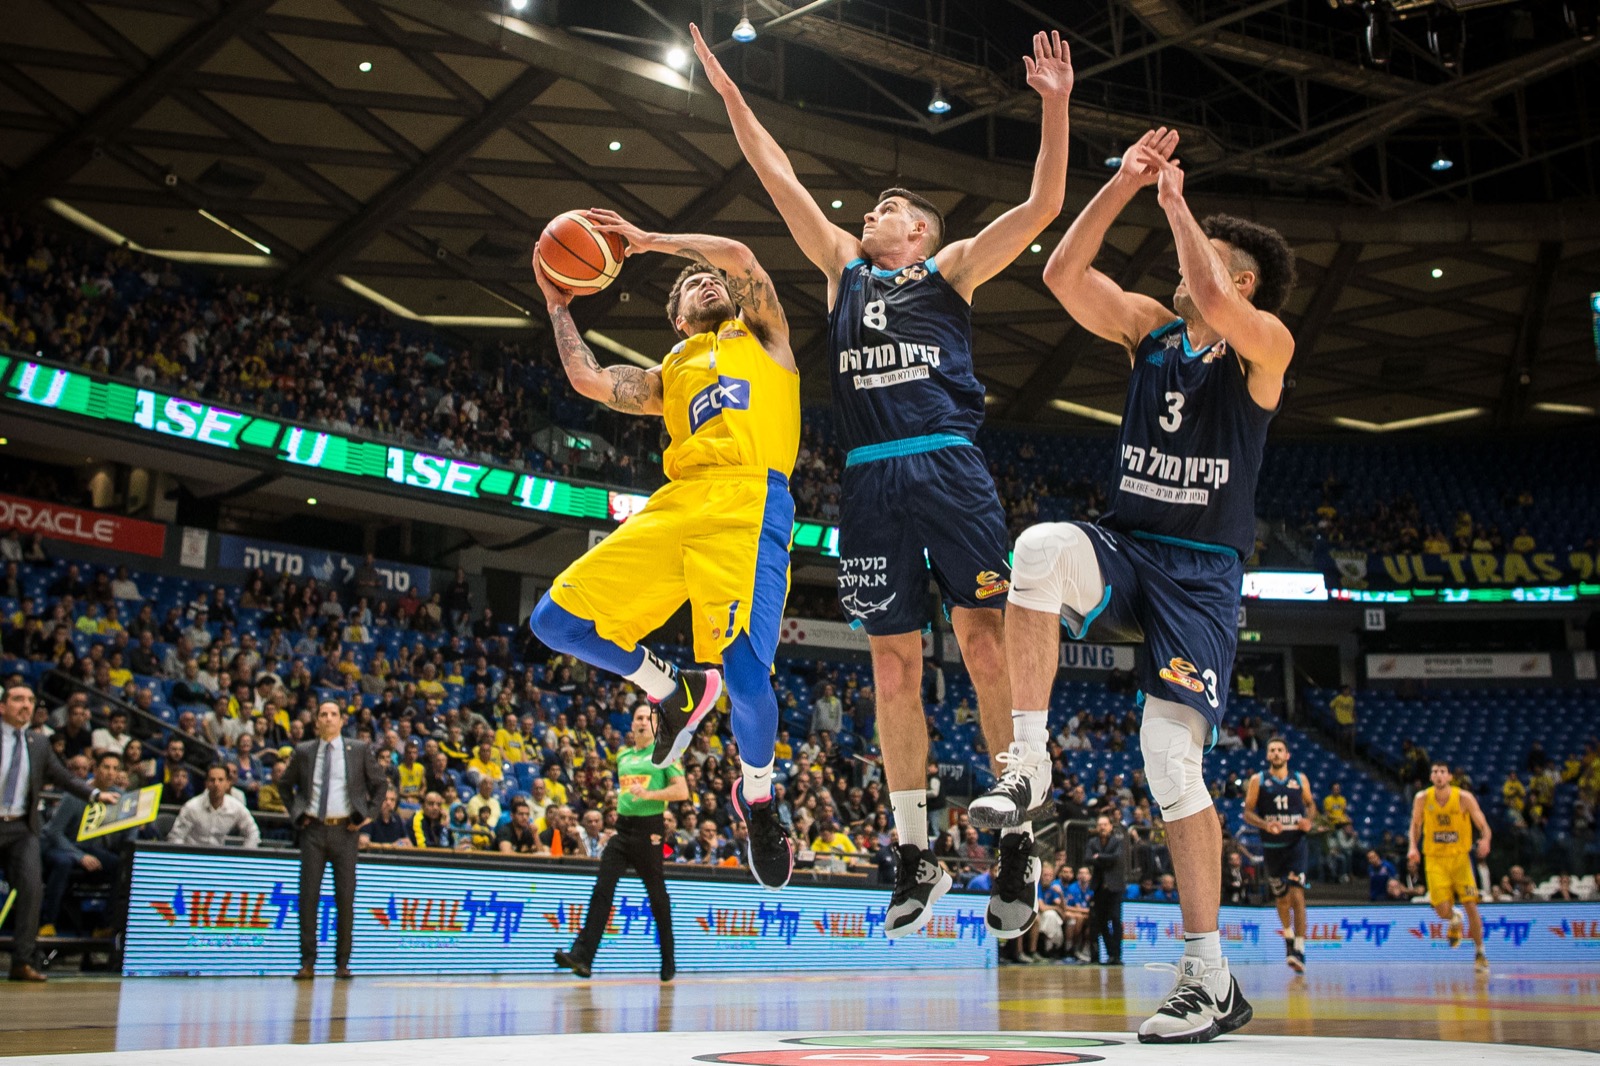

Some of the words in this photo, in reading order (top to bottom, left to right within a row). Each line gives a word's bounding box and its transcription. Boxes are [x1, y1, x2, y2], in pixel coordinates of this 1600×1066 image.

[863, 299, 887, 331] 8
[863, 344, 896, 369] מול
[899, 342, 941, 368] קניון
[1159, 391, 1185, 433] 3
[1120, 443, 1146, 473] הי
[1146, 446, 1182, 482] מול
[1182, 457, 1230, 489] קניון
[243, 546, 304, 576] מדיה
[1383, 553, 1563, 584] ULTRAS
[725, 600, 740, 638] 1
[1367, 611, 1382, 627] 11
[1060, 644, 1115, 668] UNG
[1273, 795, 1289, 810] 11
